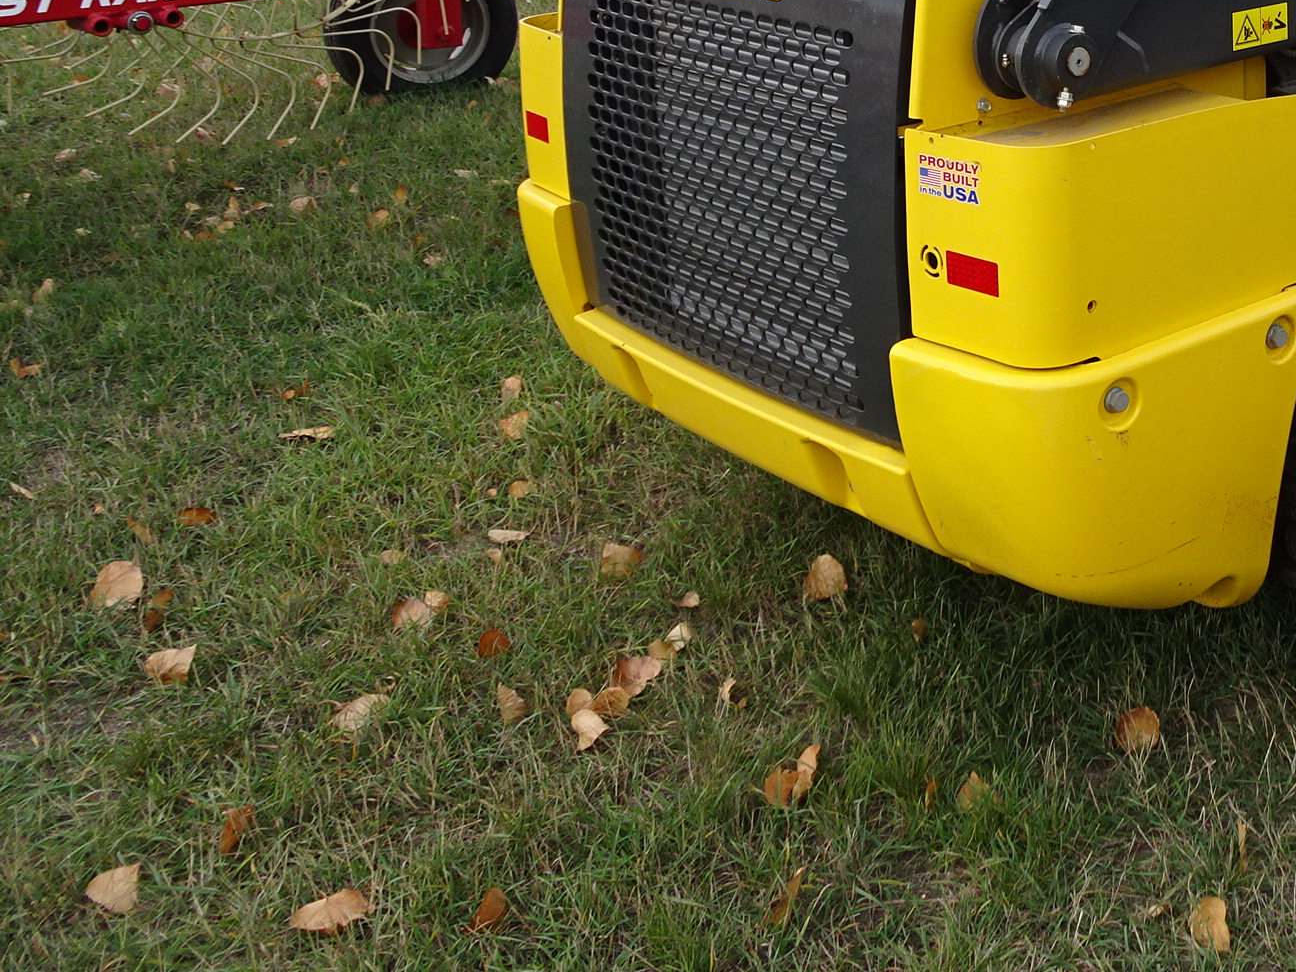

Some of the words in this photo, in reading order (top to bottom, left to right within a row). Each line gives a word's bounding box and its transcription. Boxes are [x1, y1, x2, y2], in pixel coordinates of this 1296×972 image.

[919, 154, 979, 175] PROUDLY
[943, 171, 979, 188] BUILT
[920, 185, 927, 194] in
[928, 188, 942, 197] the
[943, 184, 979, 205] USA
